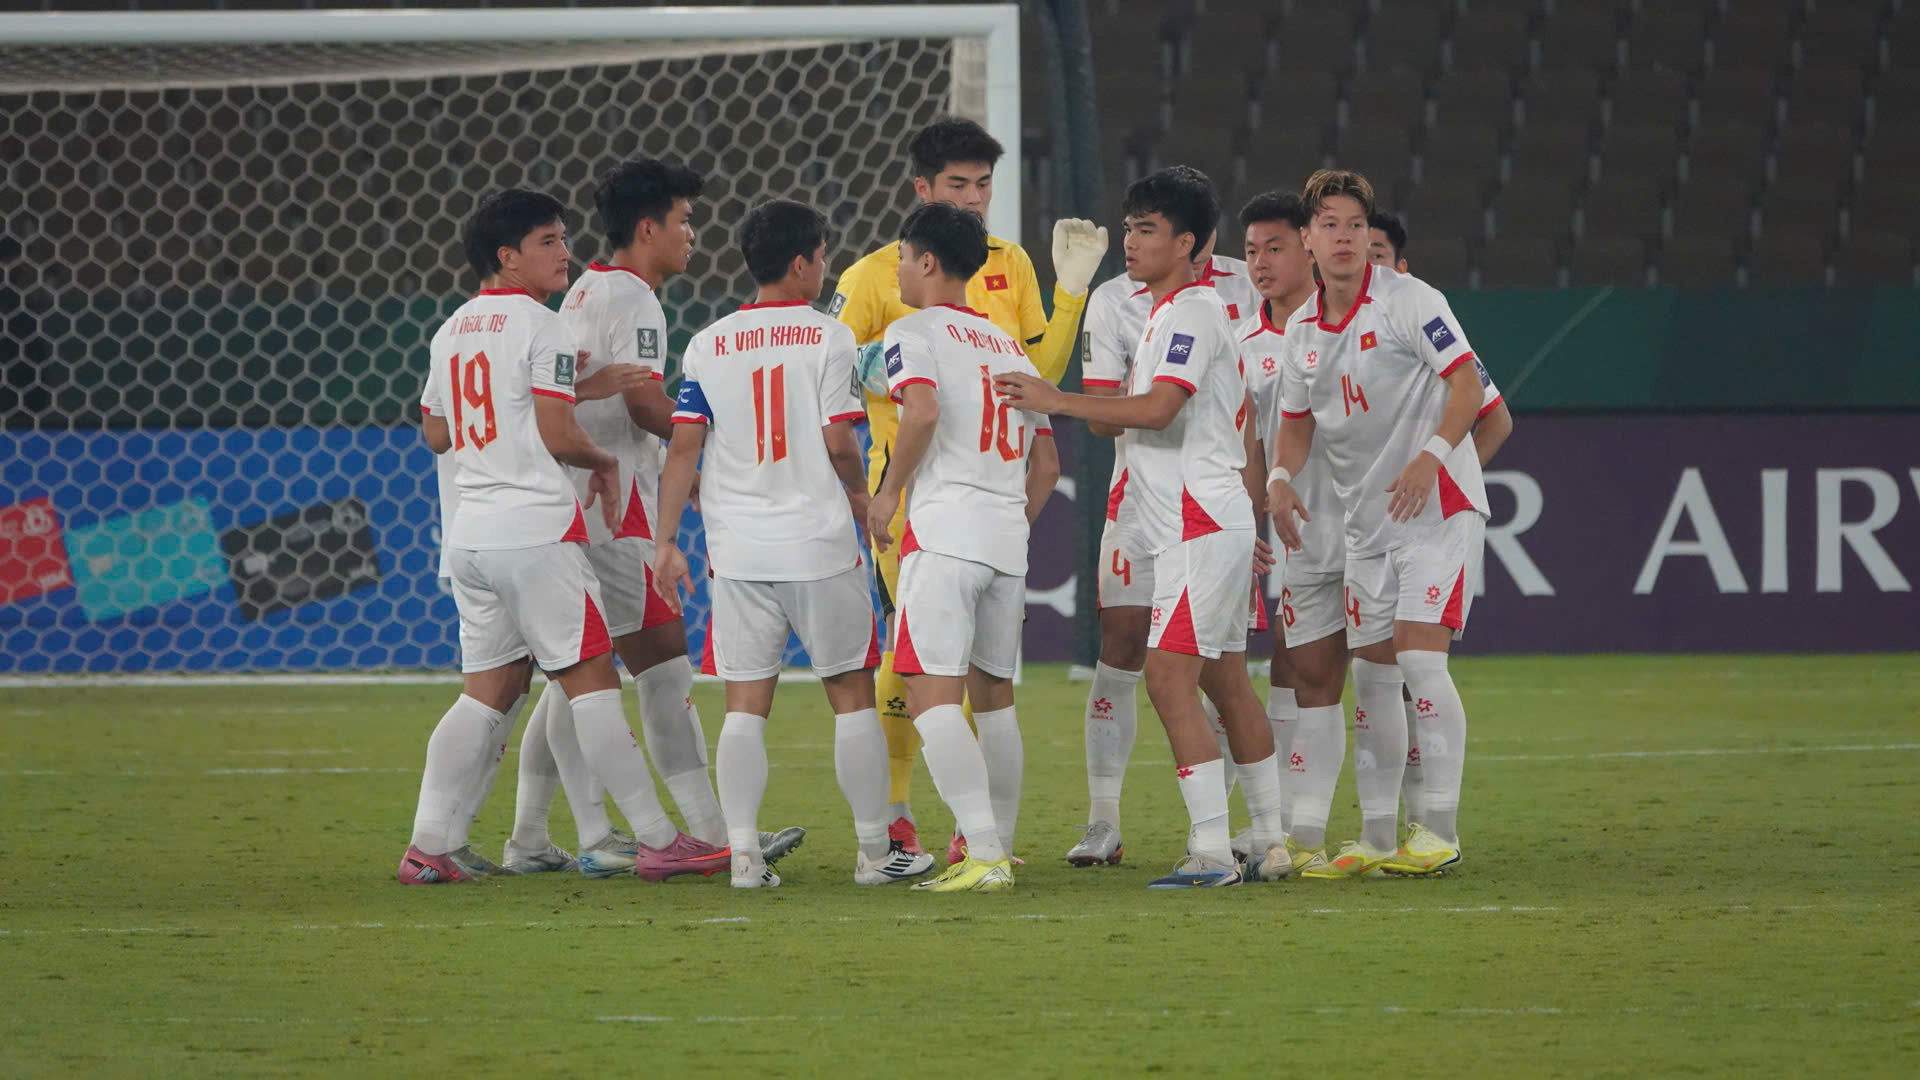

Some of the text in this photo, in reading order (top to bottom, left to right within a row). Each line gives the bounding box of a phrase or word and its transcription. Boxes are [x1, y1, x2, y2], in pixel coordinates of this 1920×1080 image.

[715, 325, 823, 356] K. VAN KHANG
[449, 350, 497, 452] 19
[752, 363, 787, 465] 11
[1341, 373, 1369, 417] 14
[1632, 466, 1920, 595] AIR
[1344, 585, 1361, 628] 4
